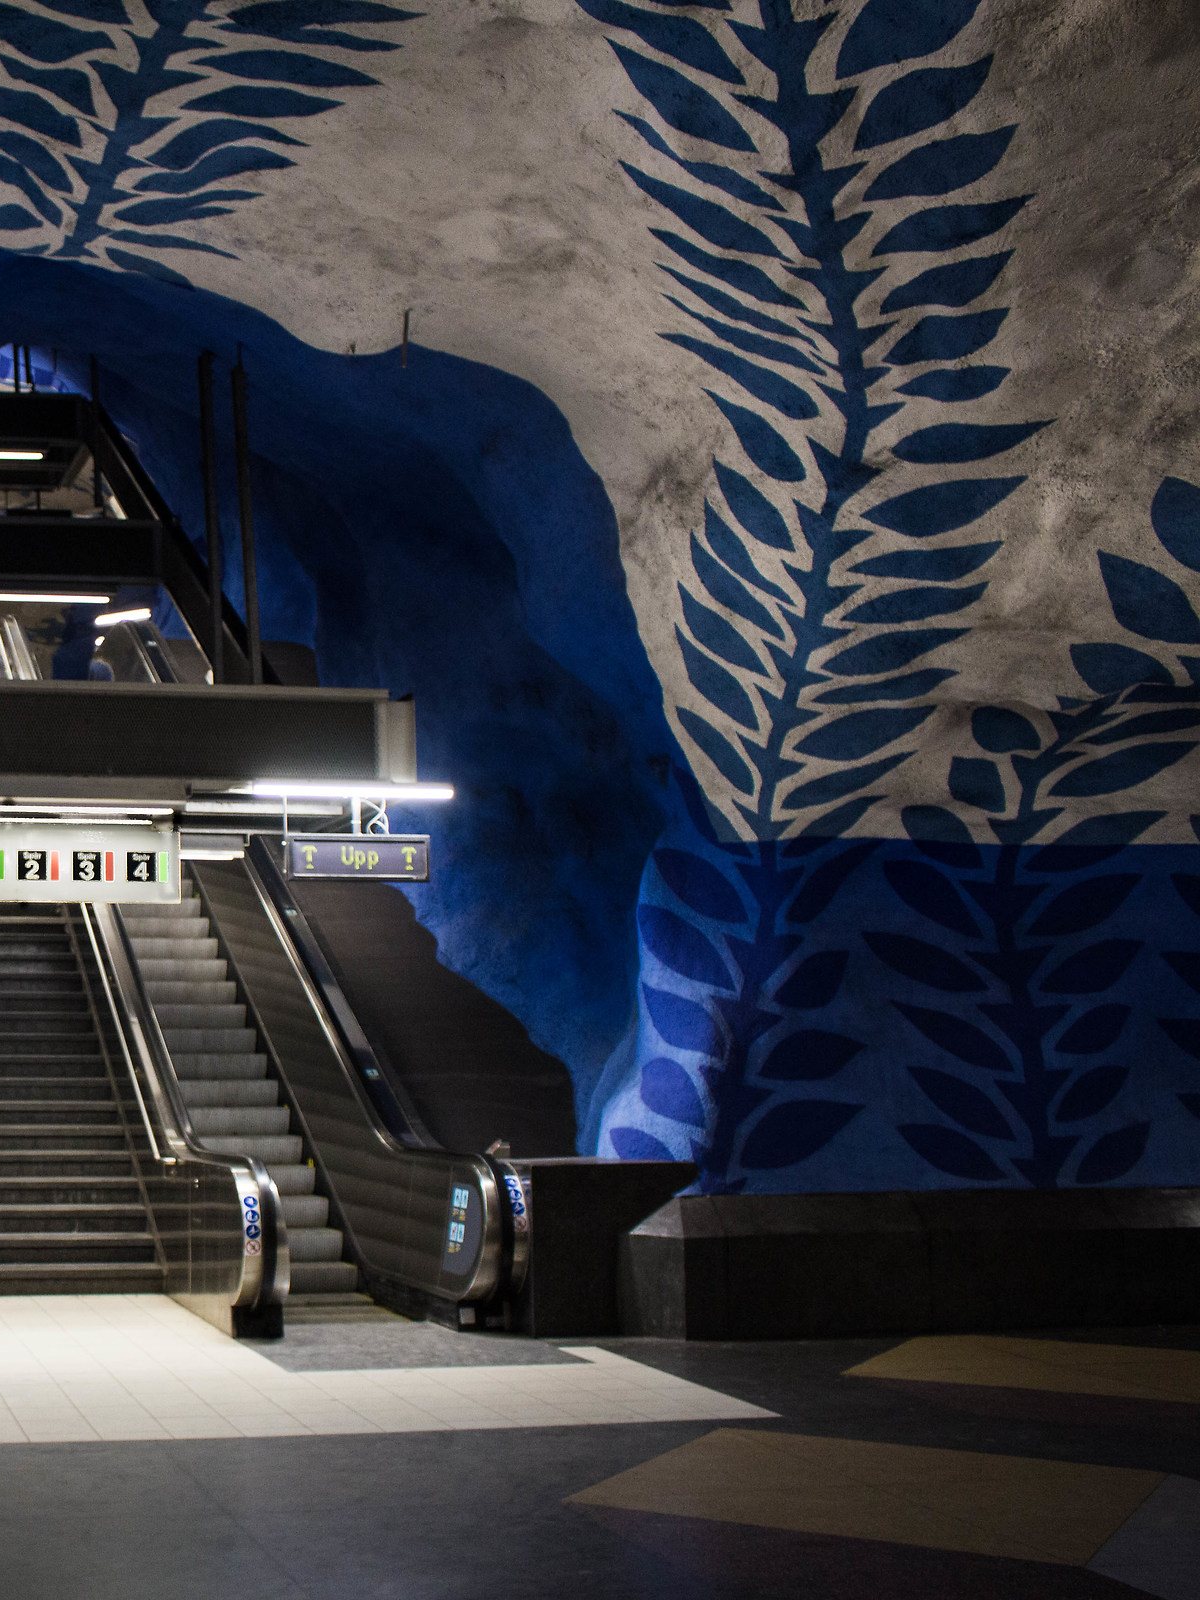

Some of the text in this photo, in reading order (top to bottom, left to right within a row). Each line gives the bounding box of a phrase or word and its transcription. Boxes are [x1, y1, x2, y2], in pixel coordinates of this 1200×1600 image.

[341, 845, 379, 870] Upp
[25, 860, 40, 880] 2
[79, 860, 95, 881] 3
[133, 861, 149, 881] 4
